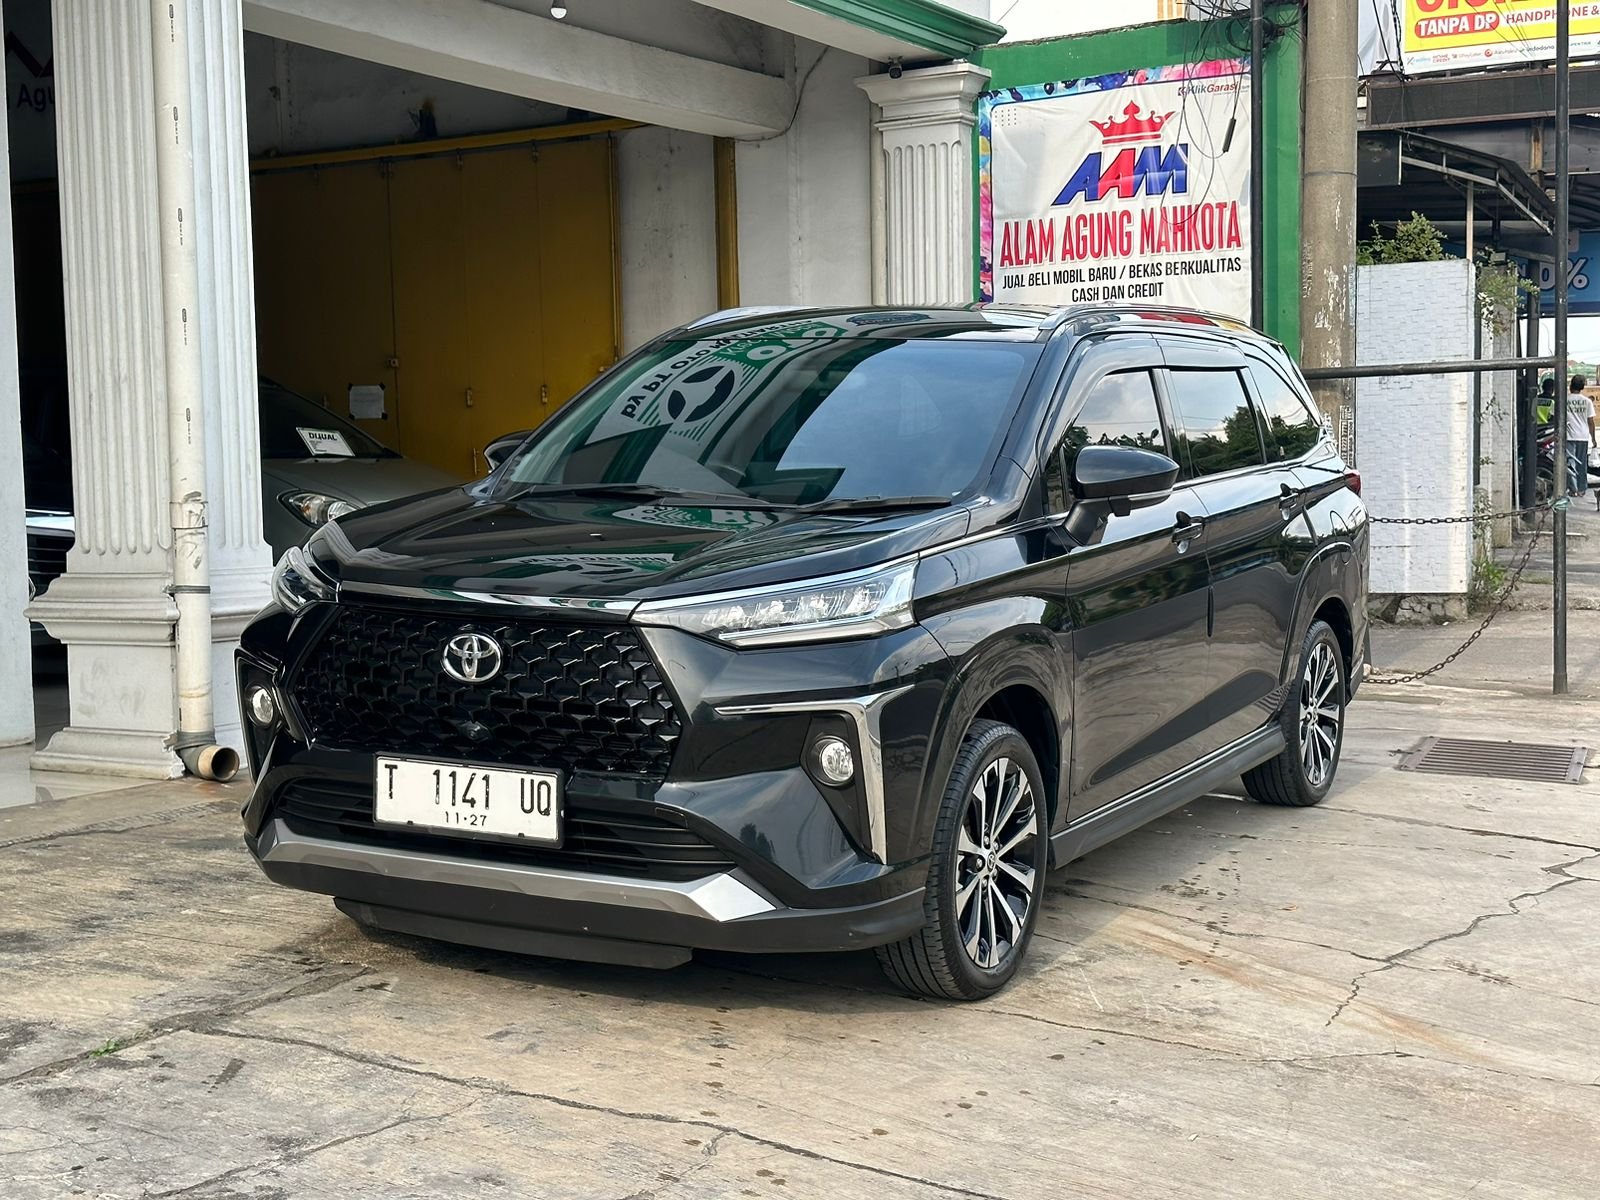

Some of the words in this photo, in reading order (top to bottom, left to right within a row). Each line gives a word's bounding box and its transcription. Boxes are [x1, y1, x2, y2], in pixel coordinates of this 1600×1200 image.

[1417, 16, 1469, 36] TANPA
[1474, 13, 1497, 31] DP
[1507, 6, 1588, 24] HANDPHNE
[1051, 143, 1189, 207] AAM
[1000, 218, 1054, 268] ALAM
[1061, 209, 1133, 262] AGUNG
[1140, 201, 1242, 255] MAHKOTA
[1002, 274, 1026, 289] JUAL
[1028, 272, 1050, 287] BELI
[1053, 269, 1085, 284] MOBIL
[1088, 267, 1116, 282] BARU
[1119, 265, 1126, 280] /
[1129, 262, 1162, 279] BEKAS
[1165, 257, 1241, 277] BERKUALITAS
[1072, 287, 1099, 303] CASH
[1102, 285, 1125, 300] DAN
[1128, 282, 1164, 299] CREDIT
[308, 432, 338, 441] DIJUAL
[384, 763, 398, 800] T
[432, 768, 490, 810] 1141
[520, 777, 552, 816] UQ
